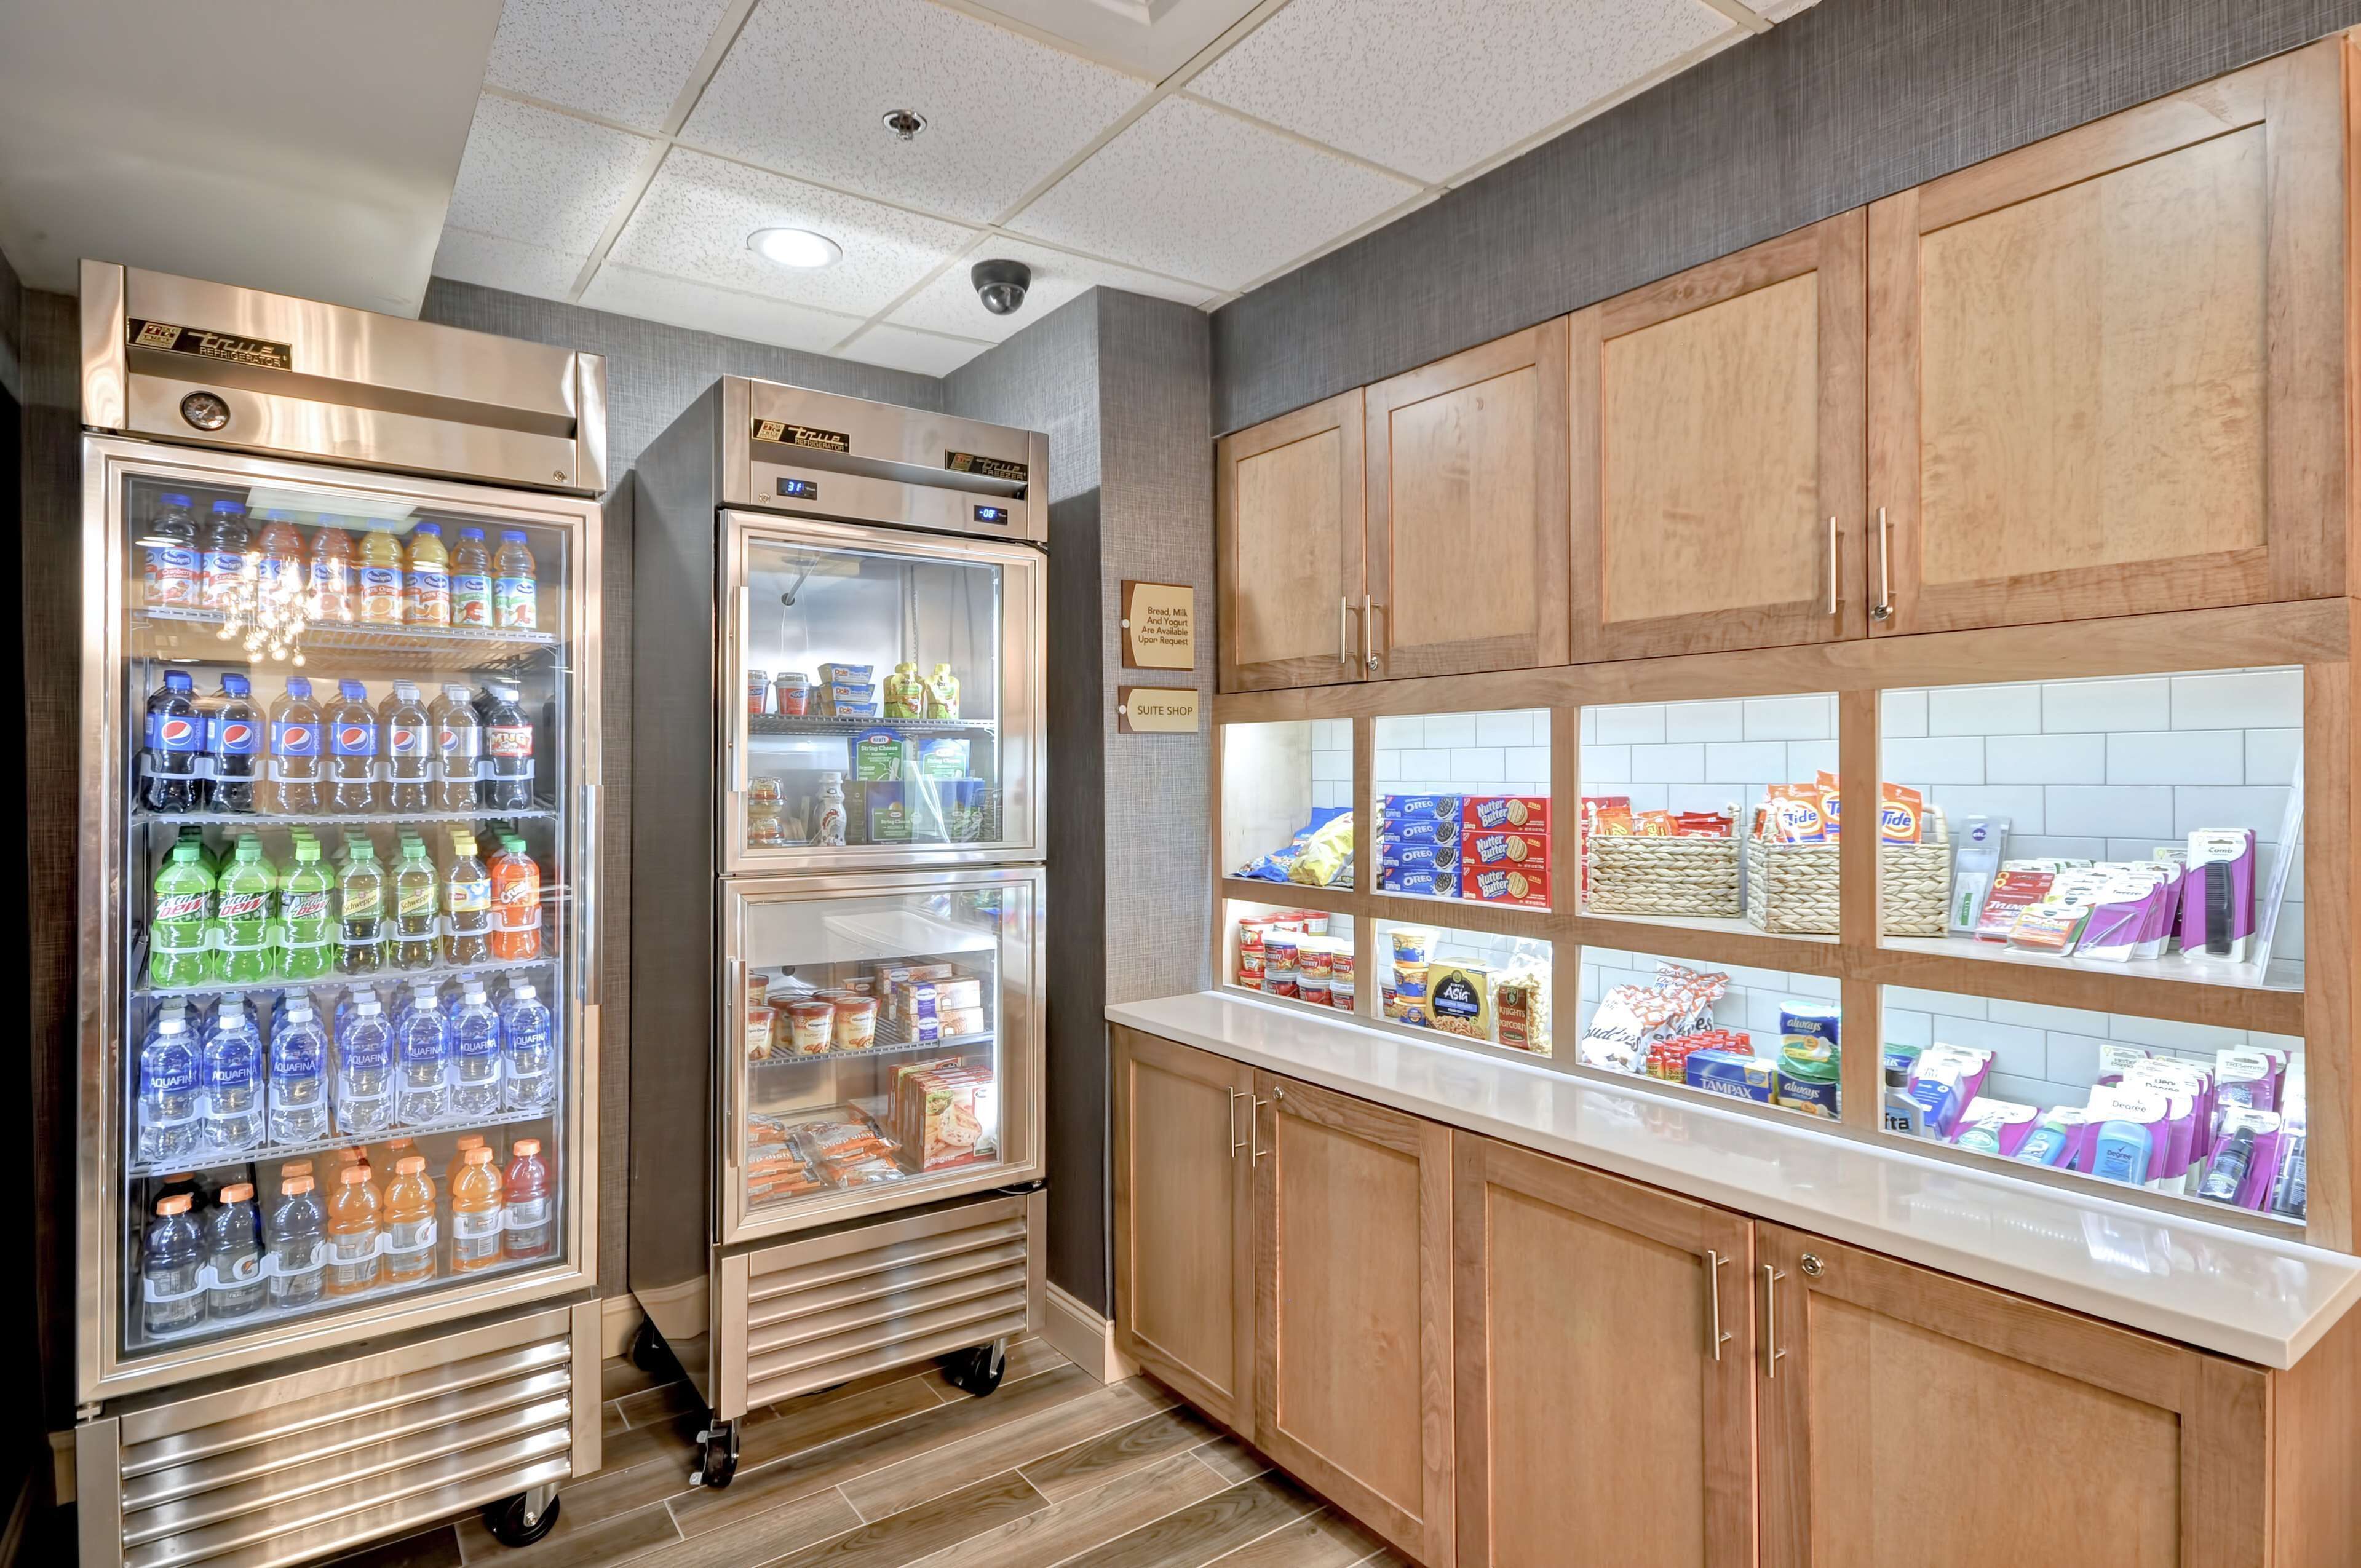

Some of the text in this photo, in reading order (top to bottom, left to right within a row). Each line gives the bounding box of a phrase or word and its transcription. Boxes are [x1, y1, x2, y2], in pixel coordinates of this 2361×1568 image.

[199, 347, 281, 367] REFRIGERATOR
[795, 438, 844, 452] REFRIGERATOR
[982, 469, 1023, 480] FREEZER
[1148, 606, 1188, 617] Bread, Milk
[1147, 616, 1188, 627] And Yogurt
[1141, 625, 1188, 636] Are Available
[1138, 635, 1188, 646] Upon Request
[835, 668, 849, 676] Dole
[1138, 705, 1193, 716] SUITE SHOP
[1404, 800, 1434, 813] OREO
[1477, 799, 1505, 817] Nutter
[1827, 800, 1839, 815] Ti
[1481, 808, 1508, 828] Butter
[1783, 810, 1817, 826] Tide
[1882, 810, 1911, 826] Tide
[1403, 825, 1434, 837] OREO
[1476, 836, 1504, 852] Nutter
[1402, 850, 1433, 862] OREO
[1480, 844, 1507, 863] Butter
[1403, 875, 1432, 887] OREO
[1477, 871, 1505, 887] Nutter
[1482, 879, 1509, 898] Butter
[1986, 901, 2025, 911] TYLENO
[1443, 985, 1470, 1002] Asia
[1787, 1016, 1822, 1032] always
[462, 1037, 496, 1052] AQUAFINA
[512, 1031, 547, 1046] AQUAFINA
[404, 1045, 443, 1056] AQUAFINA
[347, 1051, 389, 1066] AQUAFINA
[212, 1066, 258, 1082] AQUAFINA
[274, 1060, 316, 1074] AQUAFINA
[149, 1070, 197, 1088] AQUAFINA
[1699, 1077, 1753, 1099] TAMPAX
[1784, 1081, 1821, 1098] always
[2106, 1149, 2133, 1161] Degree
